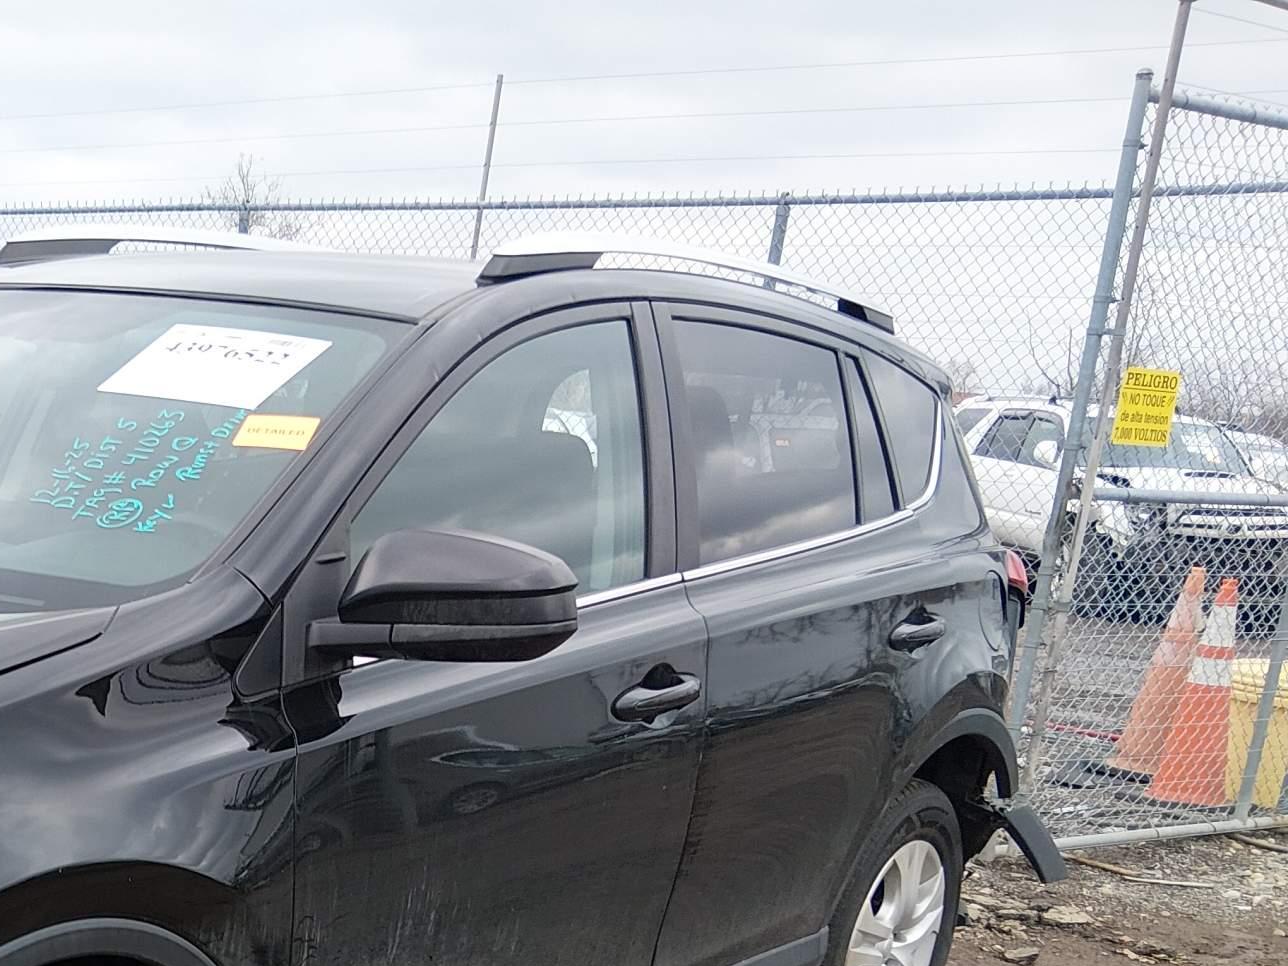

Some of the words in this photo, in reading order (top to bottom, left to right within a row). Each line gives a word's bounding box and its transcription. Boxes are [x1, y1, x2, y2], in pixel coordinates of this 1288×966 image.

[1125, 372, 1178, 390] PELIGRO
[1129, 392, 1141, 406] NO
[1142, 393, 1167, 407] TOQUE
[1120, 410, 1129, 422] de
[1130, 411, 1143, 423] alta
[1134, 427, 1168, 442] VOLTIOS
